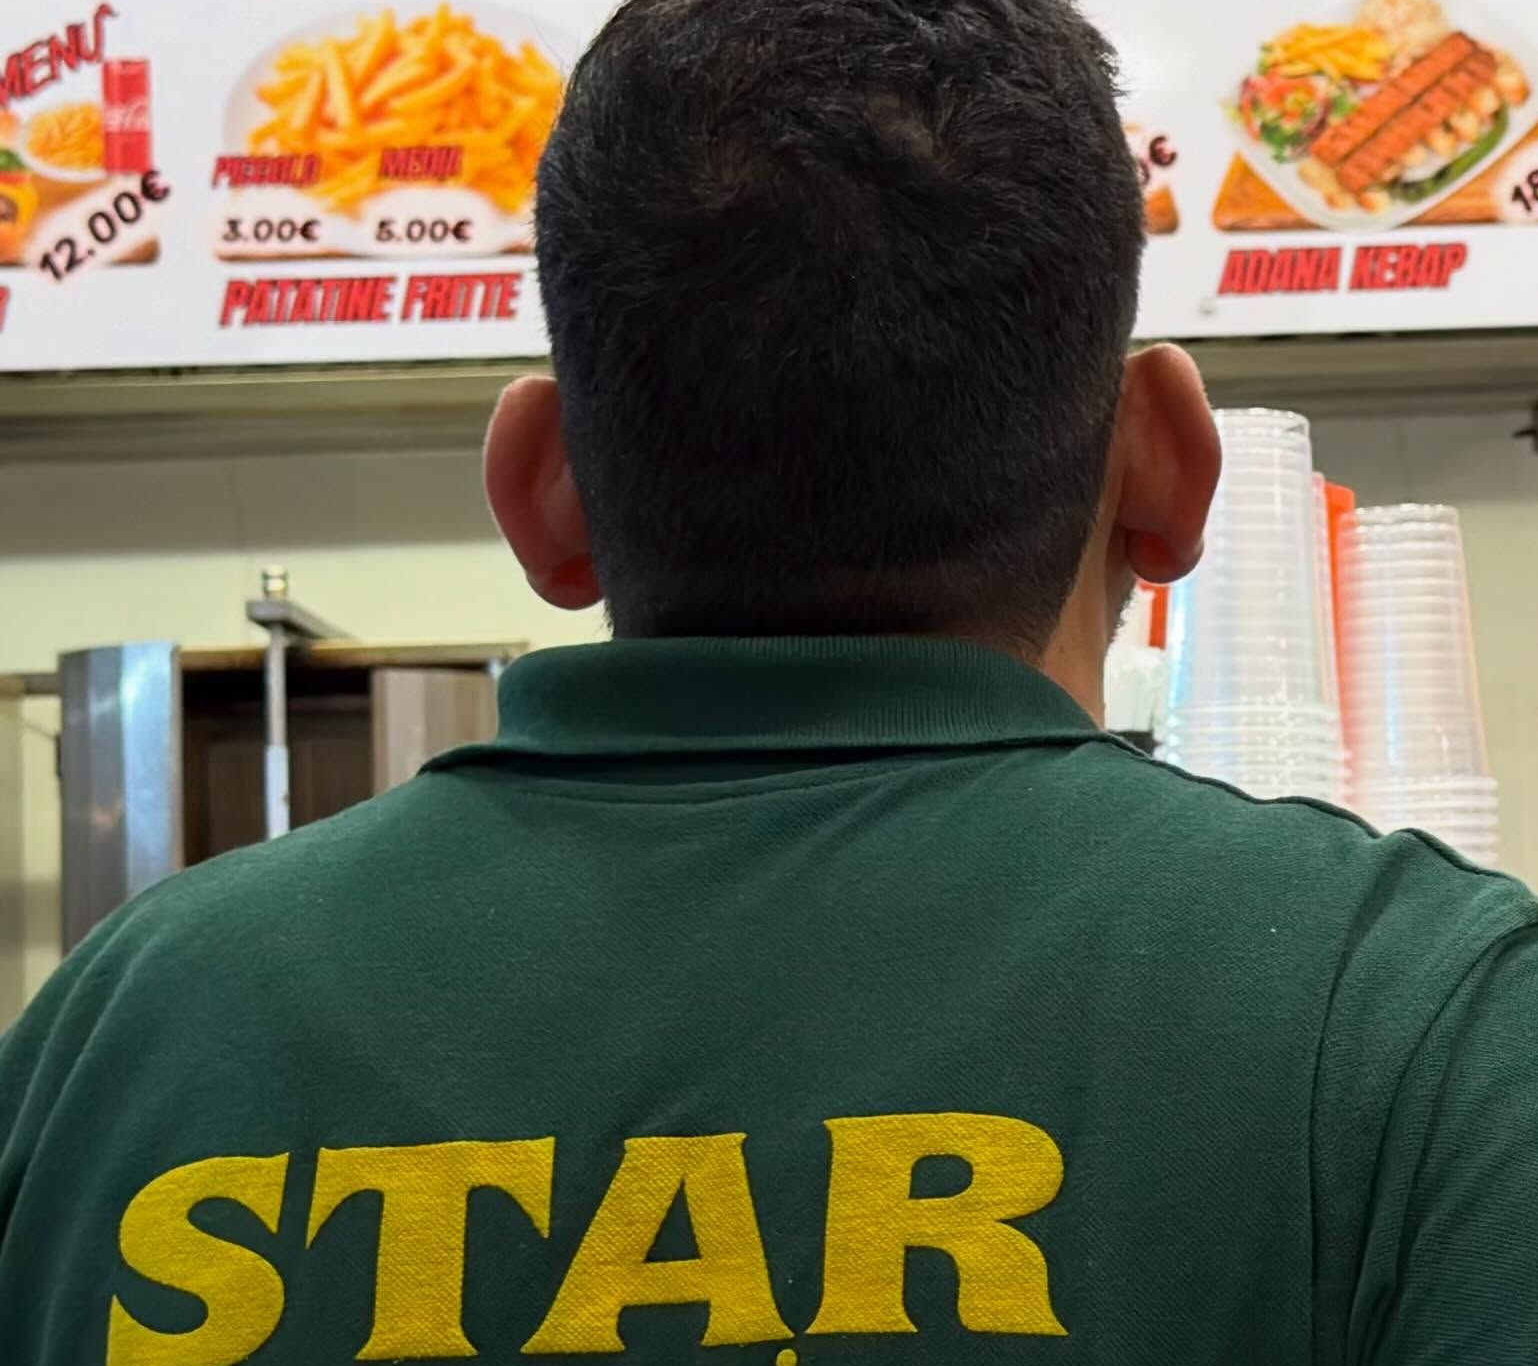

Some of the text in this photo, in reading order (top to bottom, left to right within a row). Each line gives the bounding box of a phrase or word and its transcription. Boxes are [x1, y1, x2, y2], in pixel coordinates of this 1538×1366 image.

[39, 168, 172, 284] 12.00€
[1217, 243, 1469, 297] ADANA KEBAP
[219, 271, 523, 328] PATATINE FRITTE
